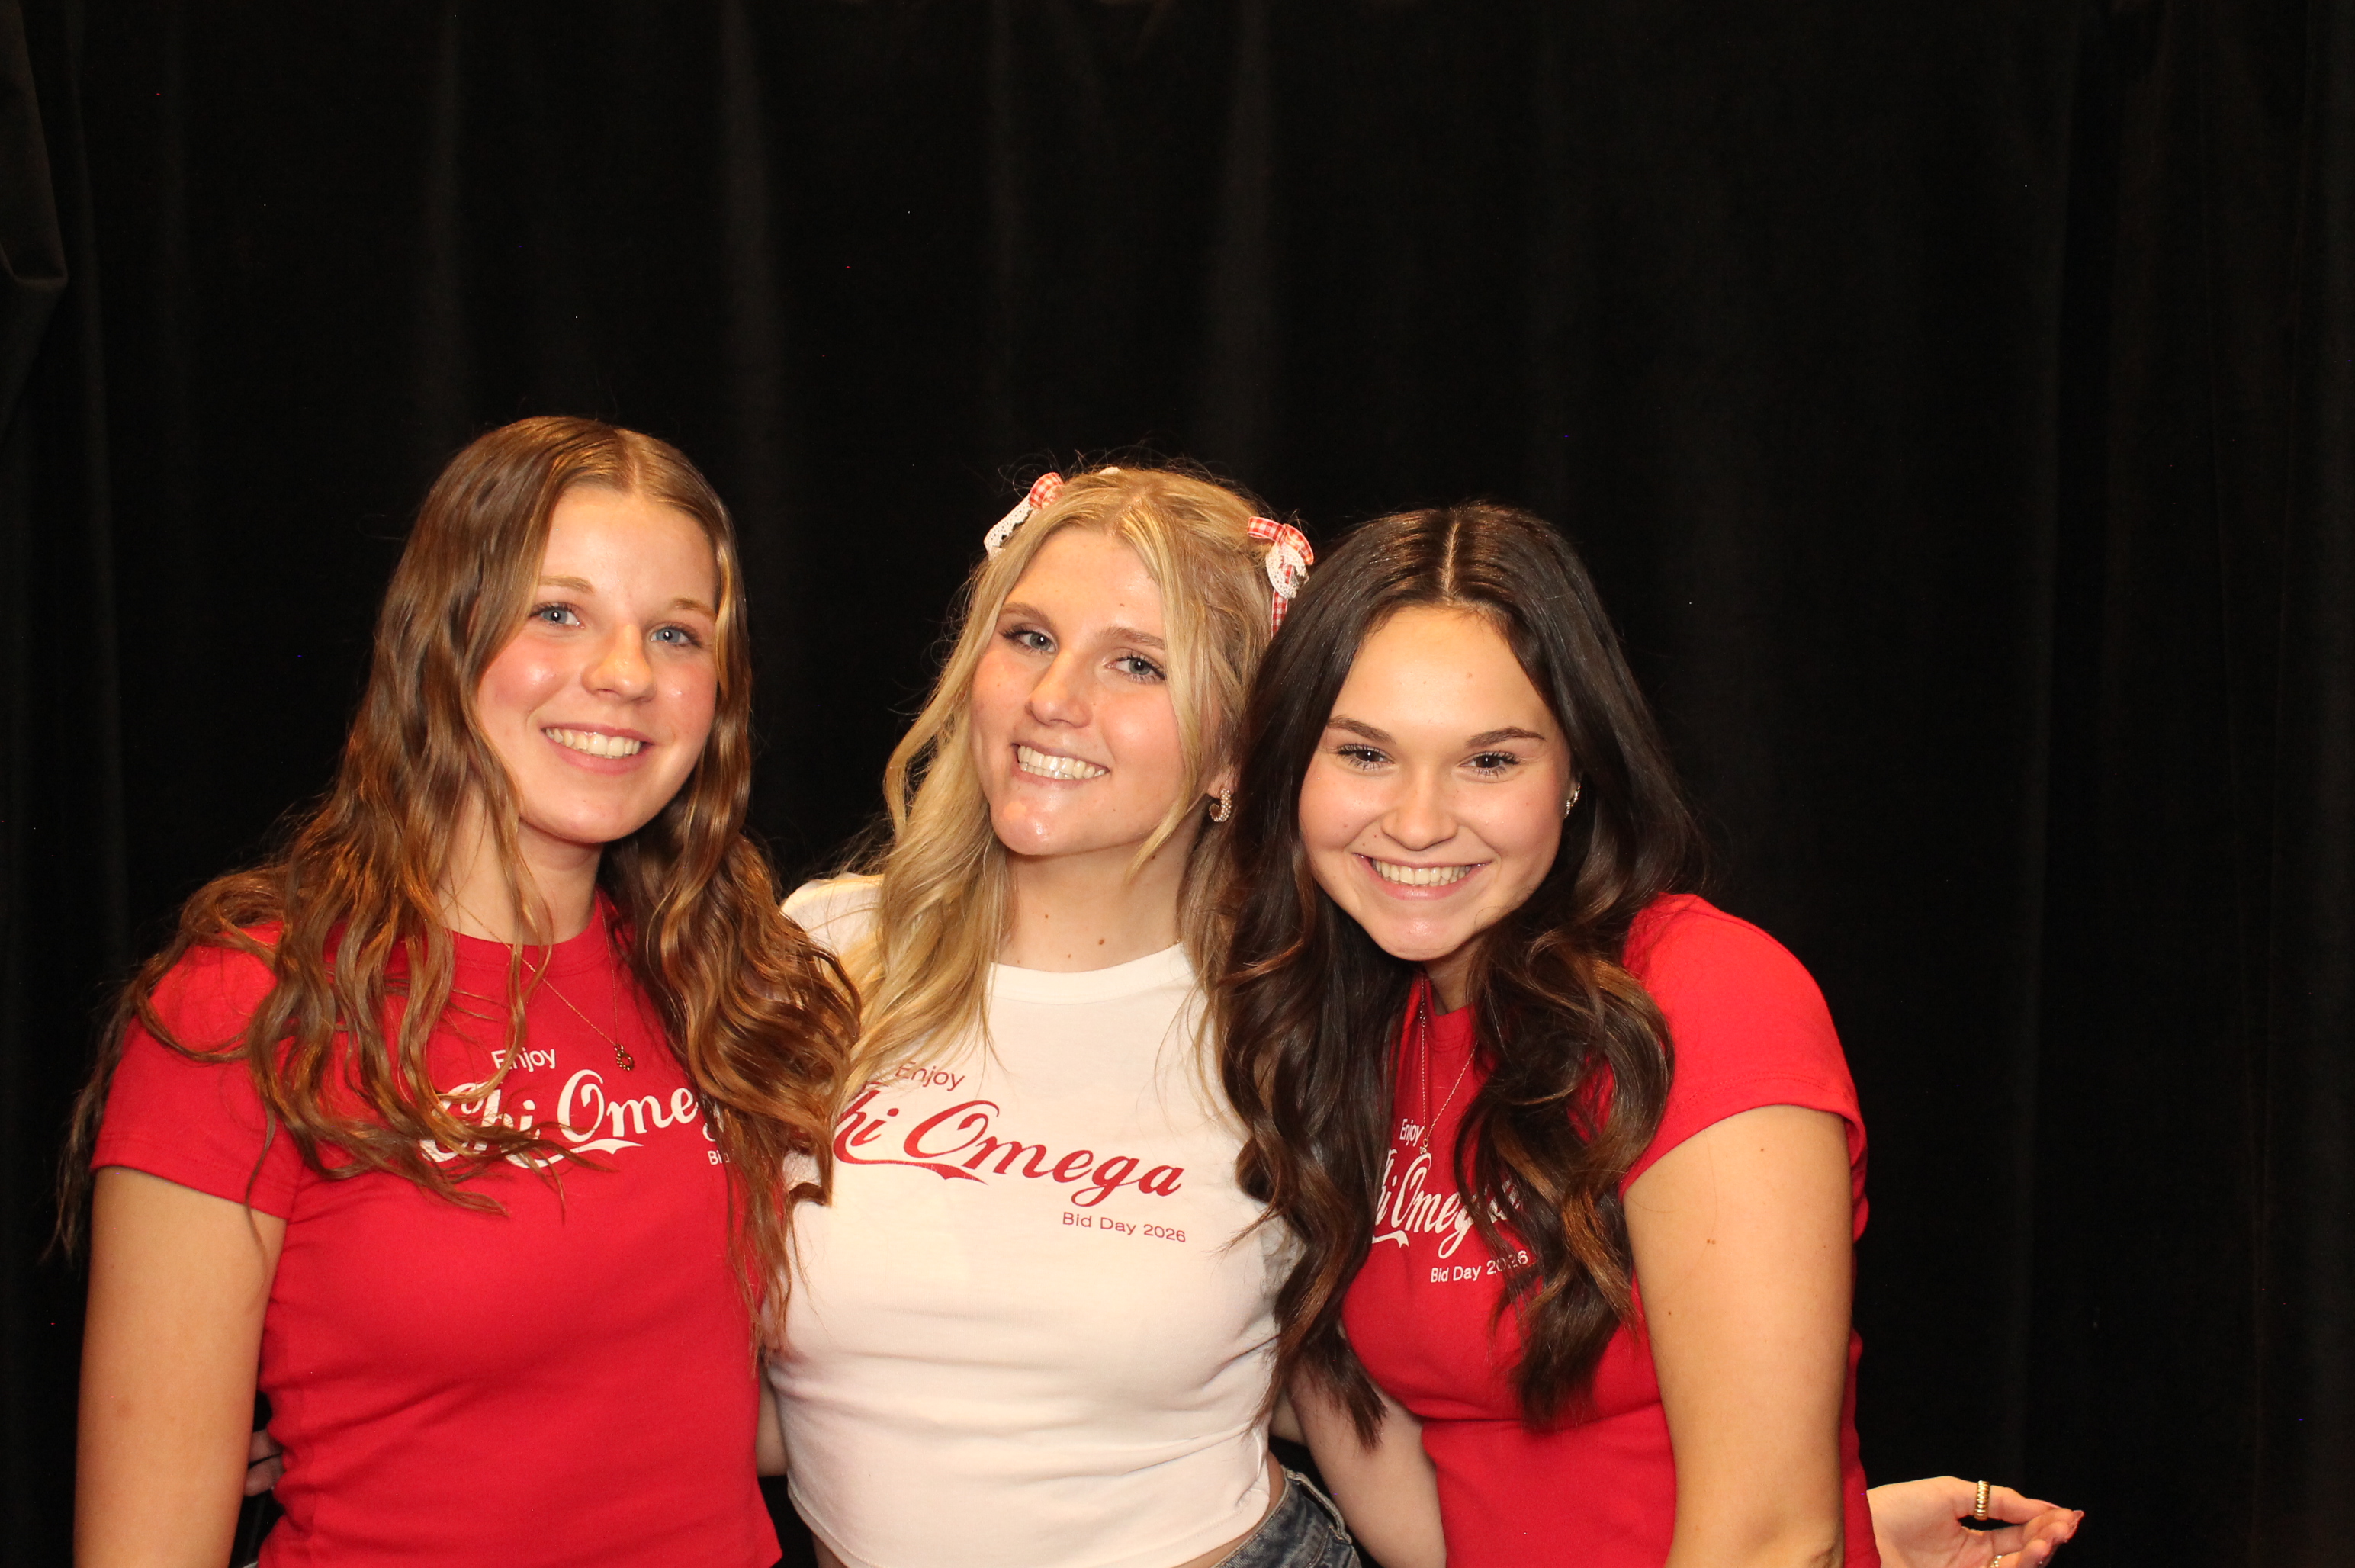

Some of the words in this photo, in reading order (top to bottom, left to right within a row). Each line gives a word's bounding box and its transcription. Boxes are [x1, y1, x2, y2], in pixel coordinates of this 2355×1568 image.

[490, 1046, 556, 1072] Enjoy
[895, 1061, 965, 1092] Enjoy
[556, 1069, 724, 1142] Ome
[1399, 1118, 1425, 1147] Enjoy
[903, 1100, 1185, 1207] Omega
[1062, 1211, 1092, 1228] Bid
[1100, 1216, 1136, 1236] Day
[1143, 1223, 1187, 1243] 2026
[1431, 1267, 1449, 1283] Bid
[1453, 1265, 1481, 1282] Day
